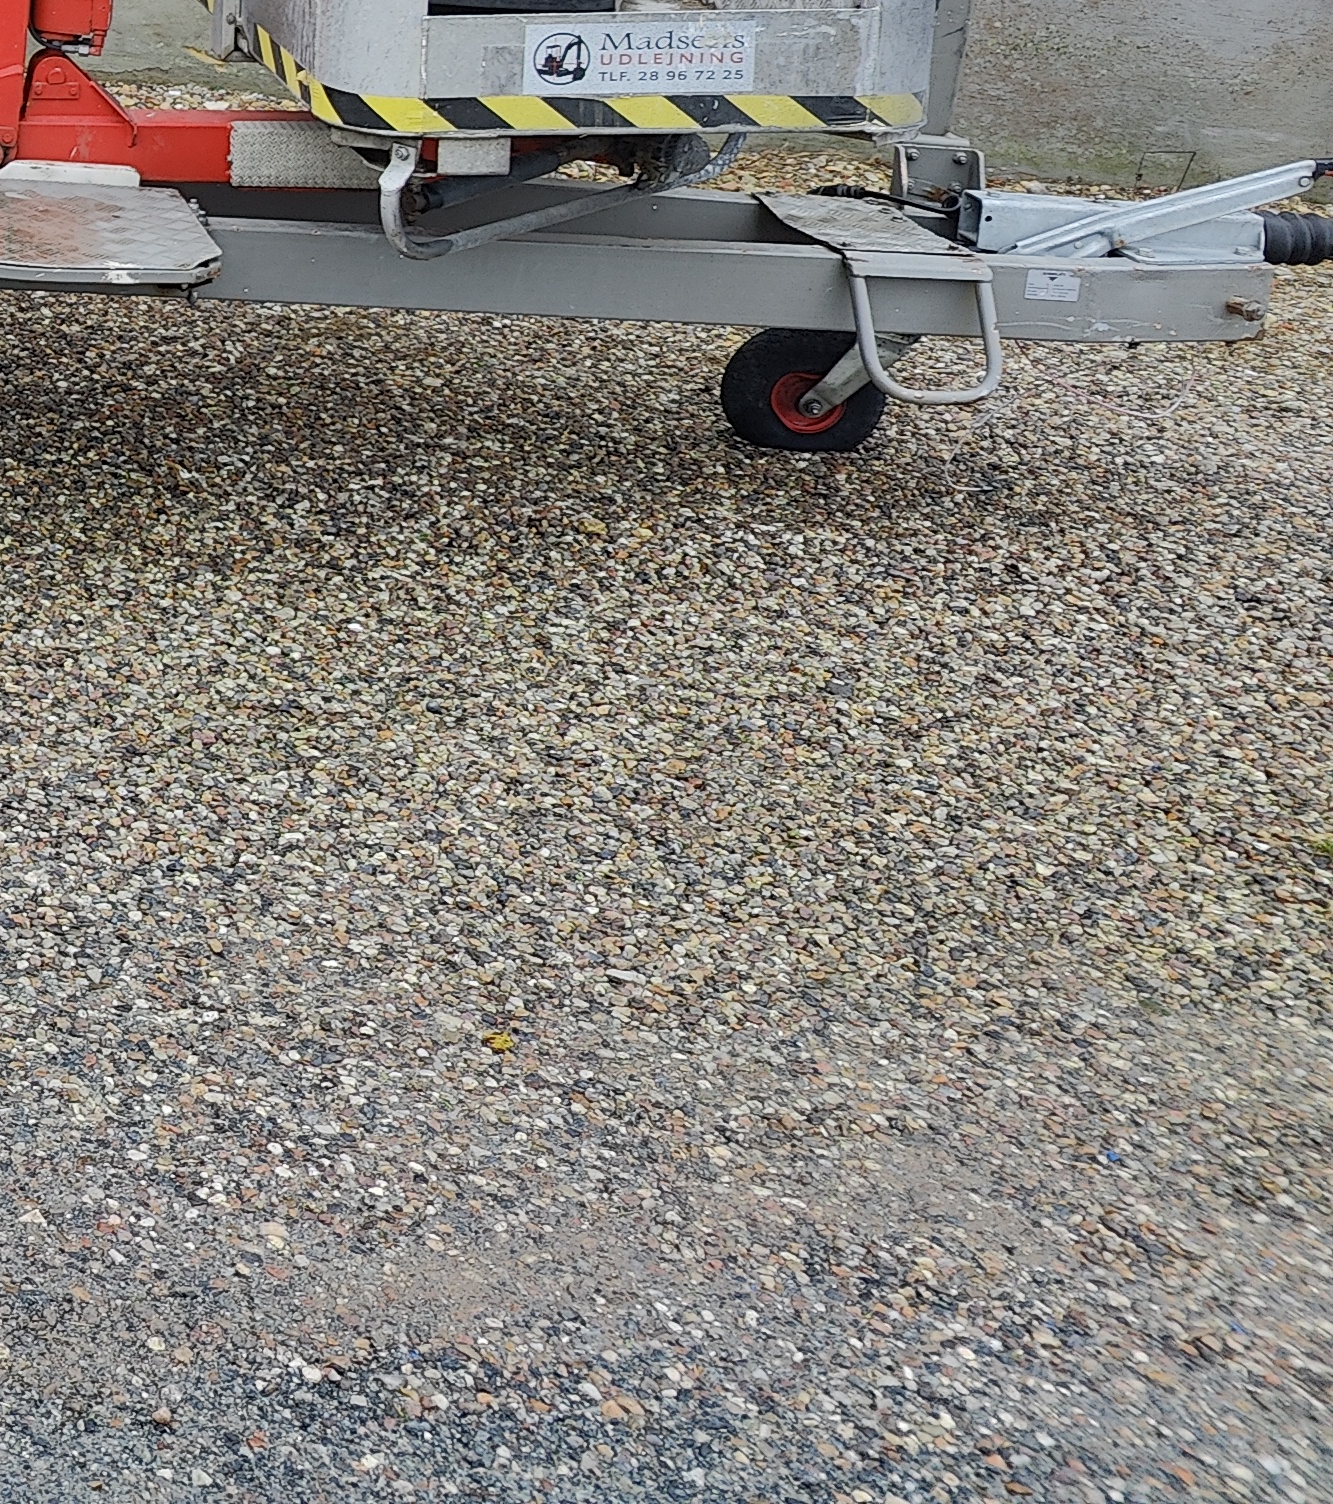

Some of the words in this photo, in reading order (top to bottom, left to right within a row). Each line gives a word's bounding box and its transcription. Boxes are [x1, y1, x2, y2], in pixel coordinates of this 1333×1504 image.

[598, 30, 745, 51] Madses
[600, 51, 744, 66] UDLEJNING
[598, 71, 631, 82] TLF.
[638, 71, 659, 81] 28
[666, 70, 688, 81] 96
[695, 70, 716, 81] 72
[722, 69, 744, 80] 25
